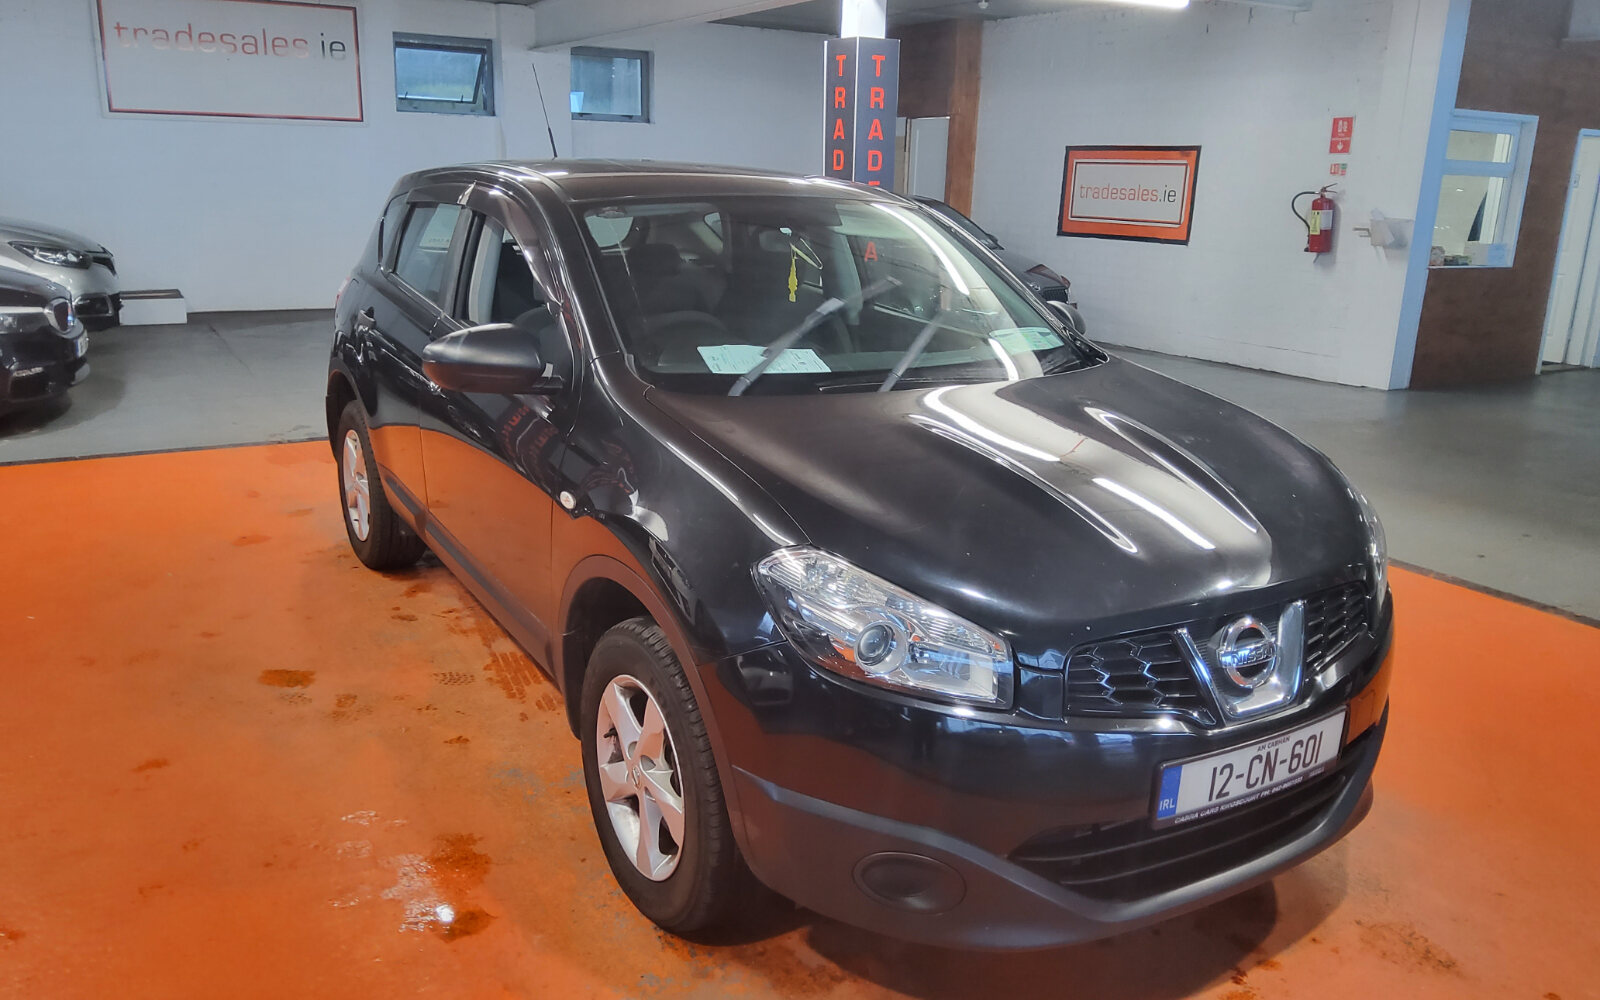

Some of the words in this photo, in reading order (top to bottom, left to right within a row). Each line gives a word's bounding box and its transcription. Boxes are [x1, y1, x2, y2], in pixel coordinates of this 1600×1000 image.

[1079, 183, 1177, 203] tradesales.ie
[1208, 731, 1323, 802] 12-CN-601
[1160, 798, 1176, 811] IRL
